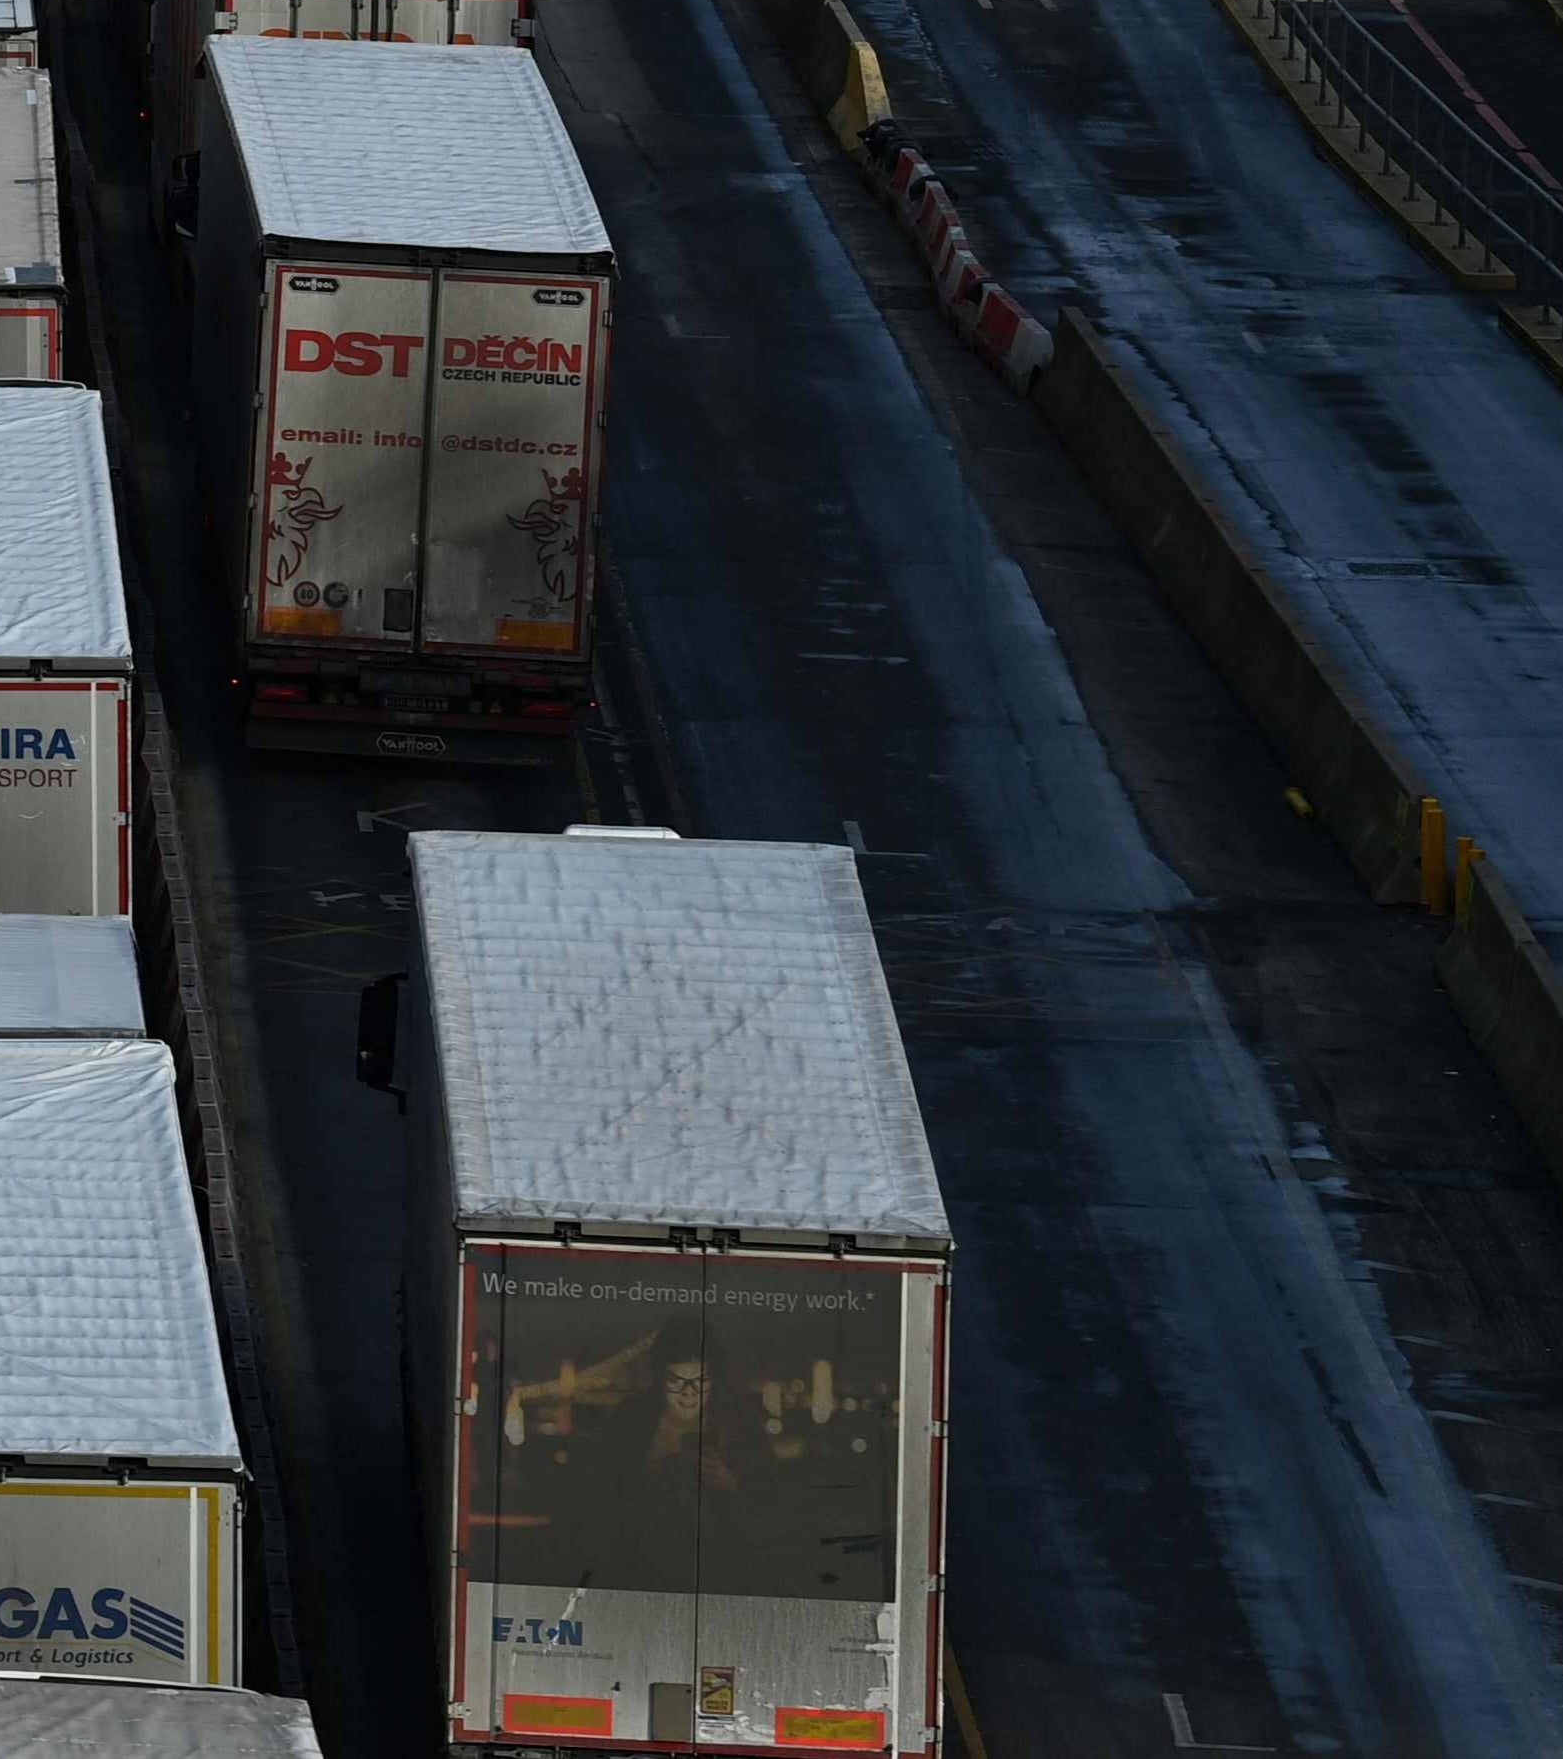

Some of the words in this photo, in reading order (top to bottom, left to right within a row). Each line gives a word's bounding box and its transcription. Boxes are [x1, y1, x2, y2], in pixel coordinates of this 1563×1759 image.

[284, 329, 423, 378] DST
[441, 334, 580, 373] DĚČÍN
[441, 368, 495, 383] CZECH
[499, 371, 579, 387] REPUBLIC
[281, 428, 363, 445] email:
[373, 430, 423, 448] info
[441, 435, 577, 456] @dstdc.cz
[483, 1271, 518, 1297] We
[525, 1277, 584, 1300] make
[590, 1279, 717, 1305] on-demand
[724, 1289, 800, 1314] energy
[30, 1649, 42, 1664] &
[51, 1648, 135, 1667] Logistics
